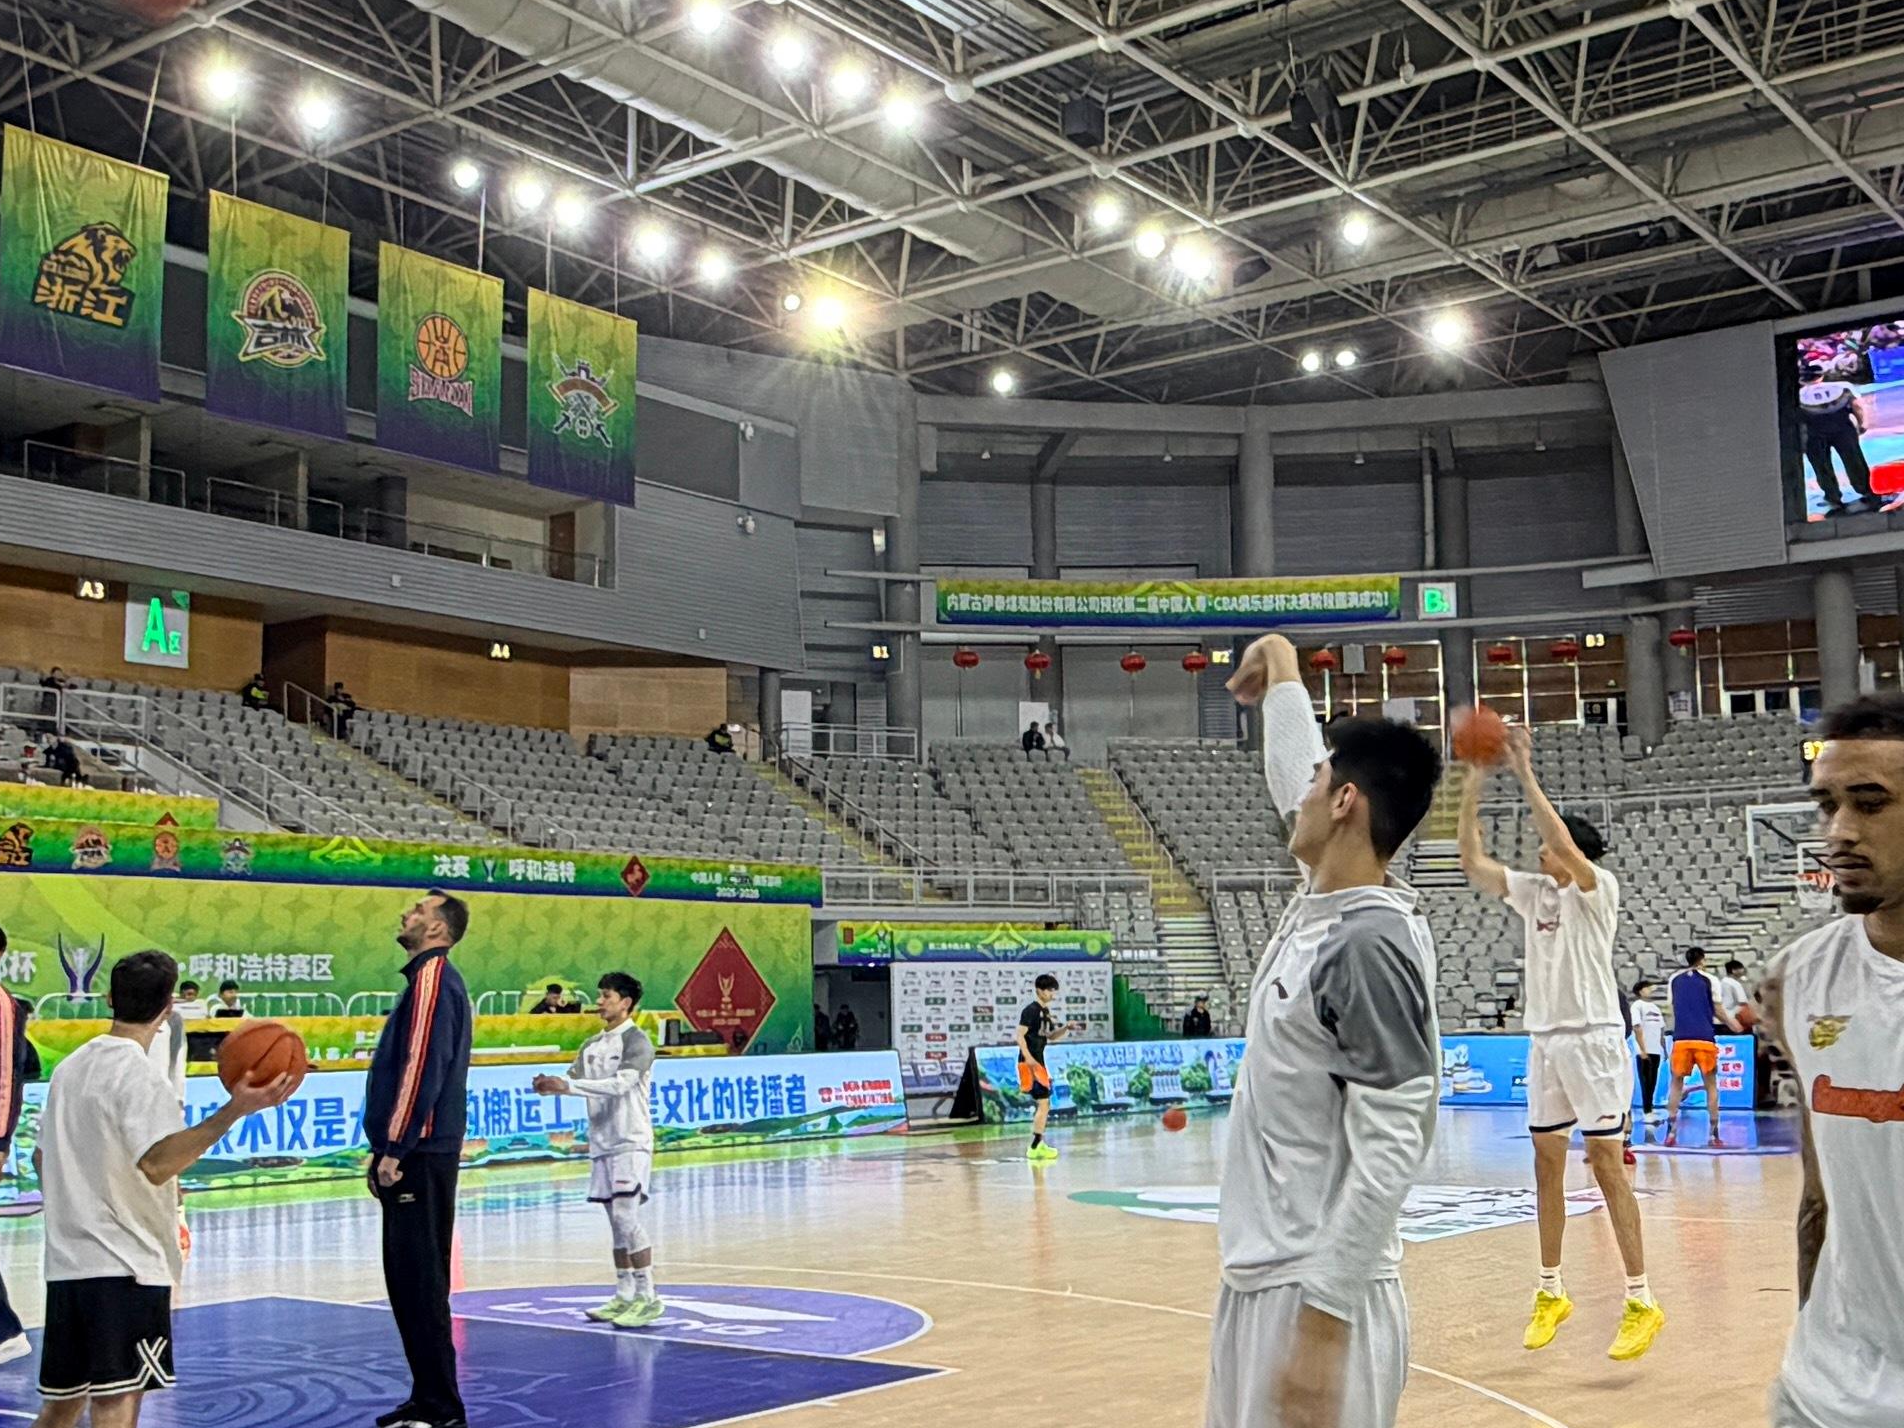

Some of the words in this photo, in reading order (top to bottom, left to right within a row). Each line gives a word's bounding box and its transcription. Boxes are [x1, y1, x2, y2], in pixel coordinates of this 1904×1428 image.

[33, 274, 129, 328] 浙江
[79, 580, 105, 600] A3
[1585, 633, 1605, 648] B3
